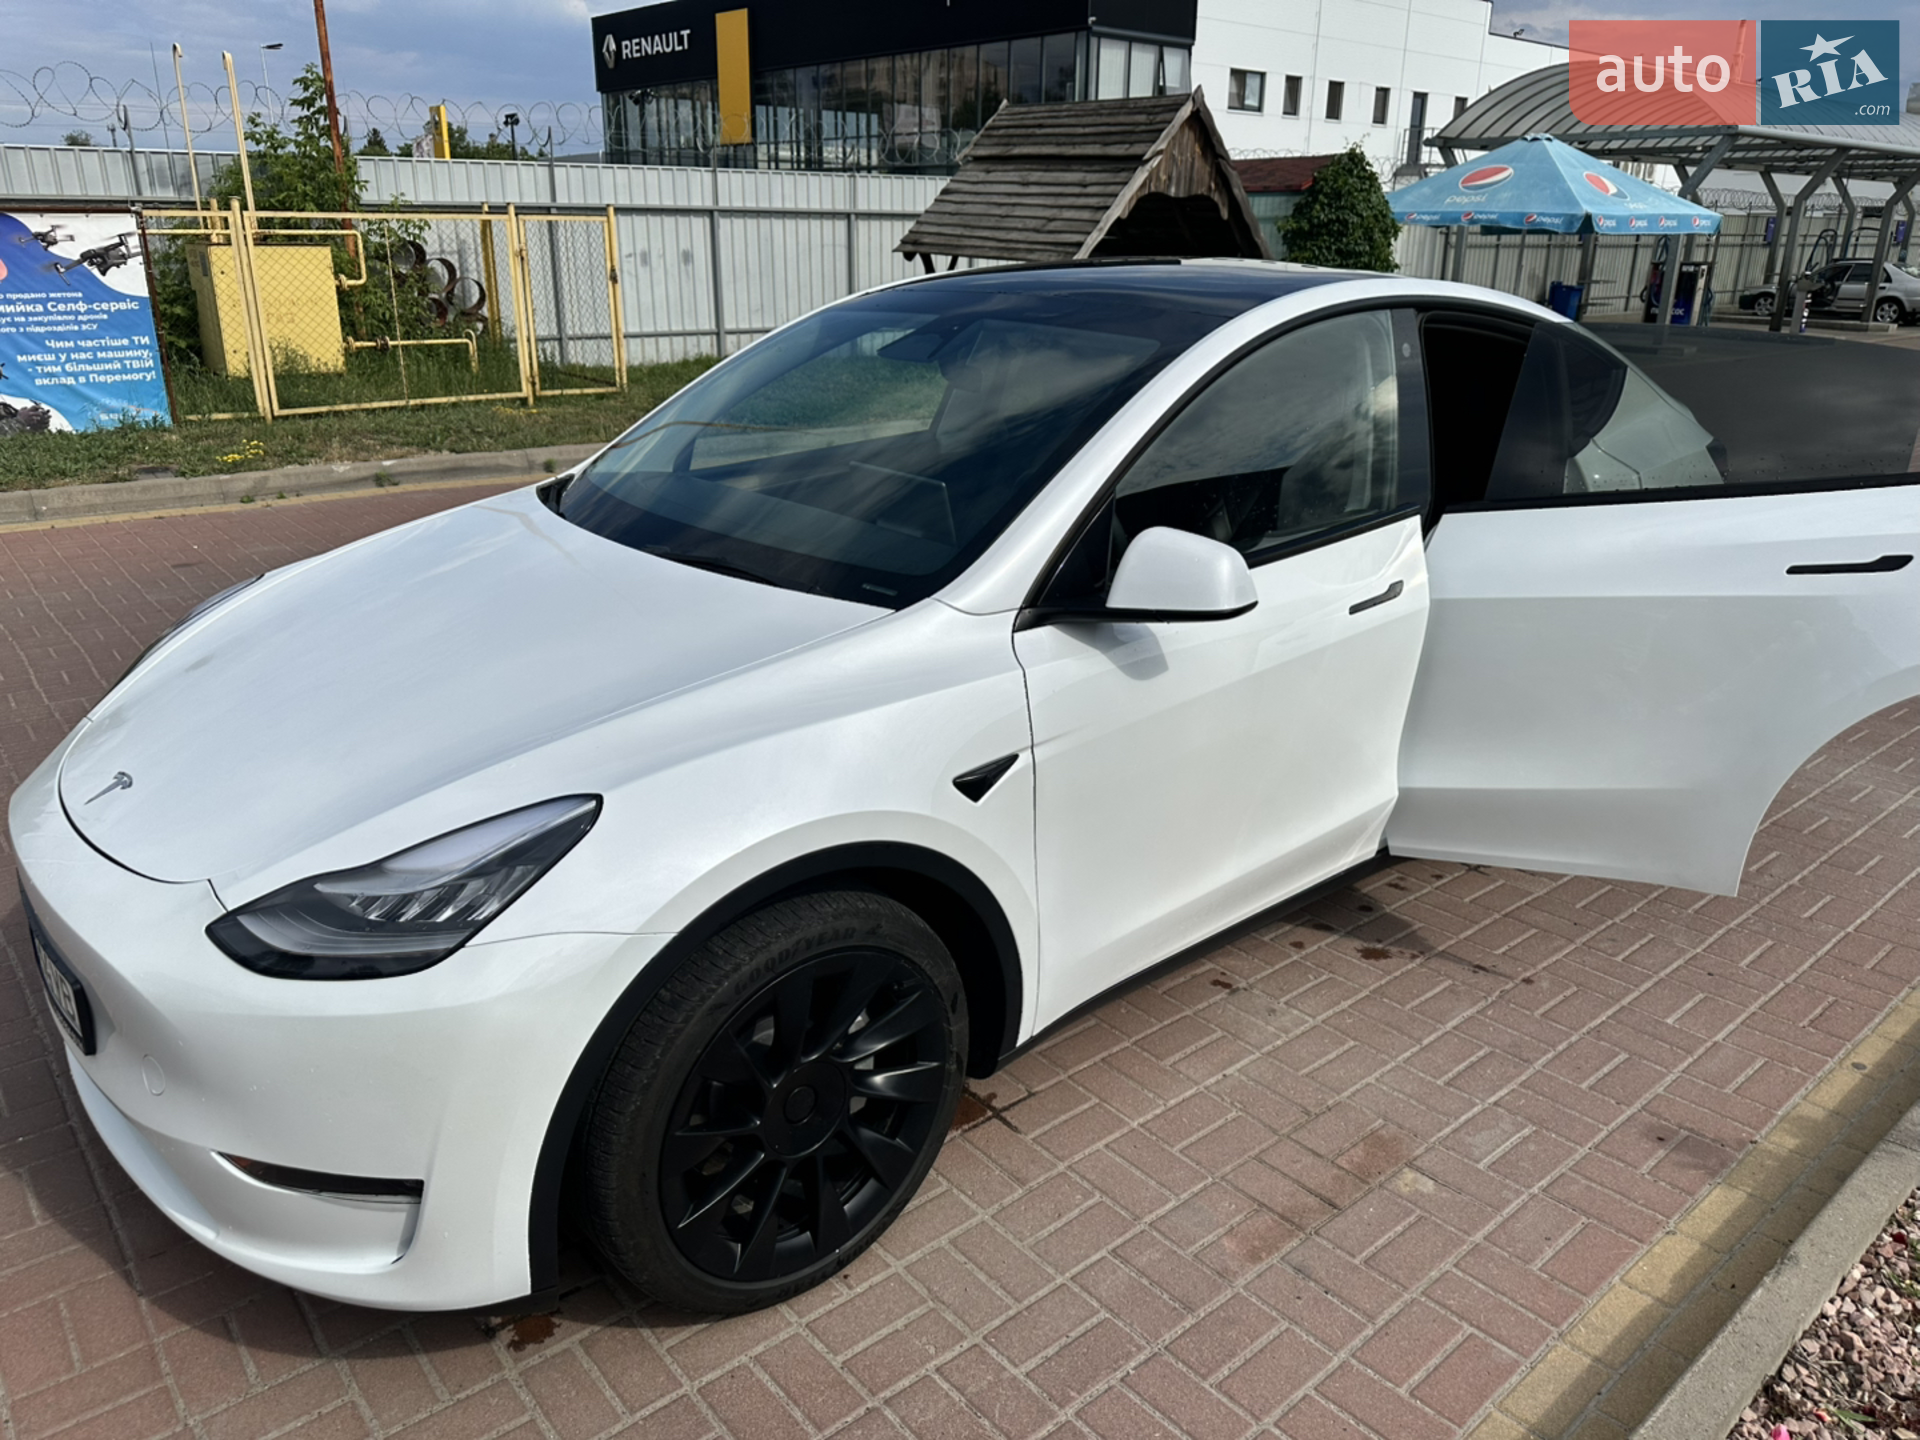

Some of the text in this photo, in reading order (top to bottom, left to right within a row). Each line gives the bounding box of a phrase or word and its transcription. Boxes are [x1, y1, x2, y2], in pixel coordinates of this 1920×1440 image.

[621, 29, 691, 60] RENAULT
[1443, 193, 1488, 206] pepsi
[47, 298, 140, 313] Селф-сервіс
[45, 335, 150, 349] Чим частіше ТИ
[17, 352, 56, 363] миєш
[58, 352, 67, 362] у
[70, 351, 94, 360] нас
[35, 364, 62, 374] тим
[65, 359, 121, 373] більший
[124, 357, 154, 369] ТВІЙ
[35, 370, 157, 386] вклад в Перемогу!
